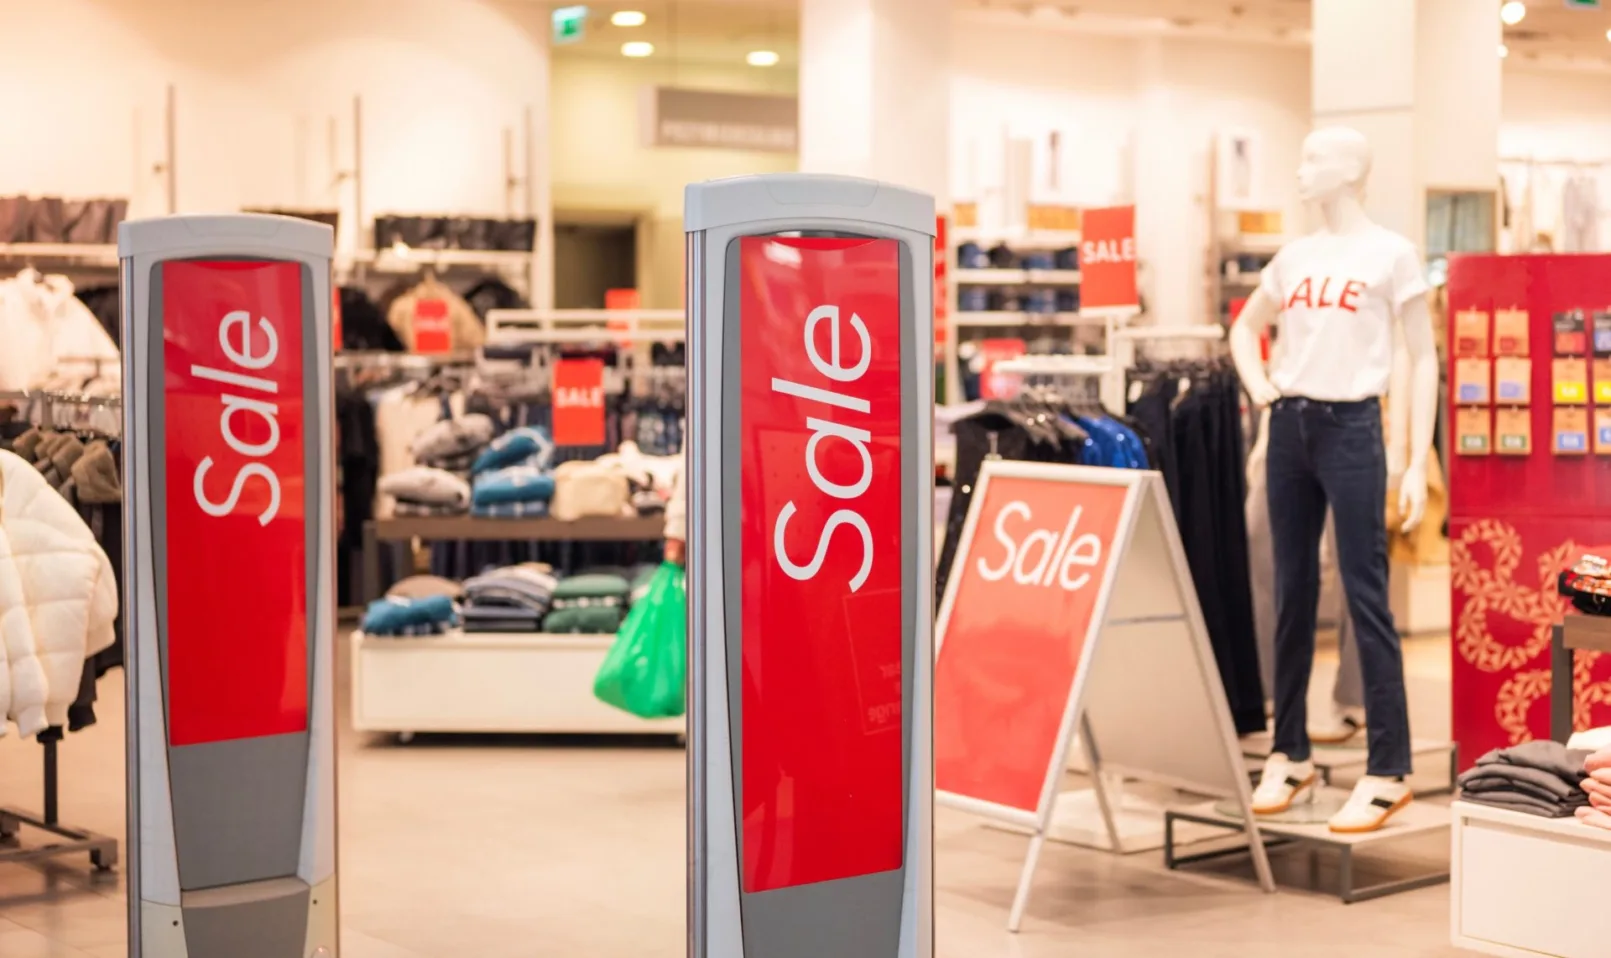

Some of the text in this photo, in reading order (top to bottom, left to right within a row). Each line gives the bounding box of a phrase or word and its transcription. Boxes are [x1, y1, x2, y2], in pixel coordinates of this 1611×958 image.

[1082, 237, 1137, 264] SALE
[1280, 276, 1366, 313] ALE
[191, 310, 281, 527] Sale
[556, 386, 604, 408] SALE
[772, 304, 874, 594] Sale
[977, 500, 1102, 591] Sale
